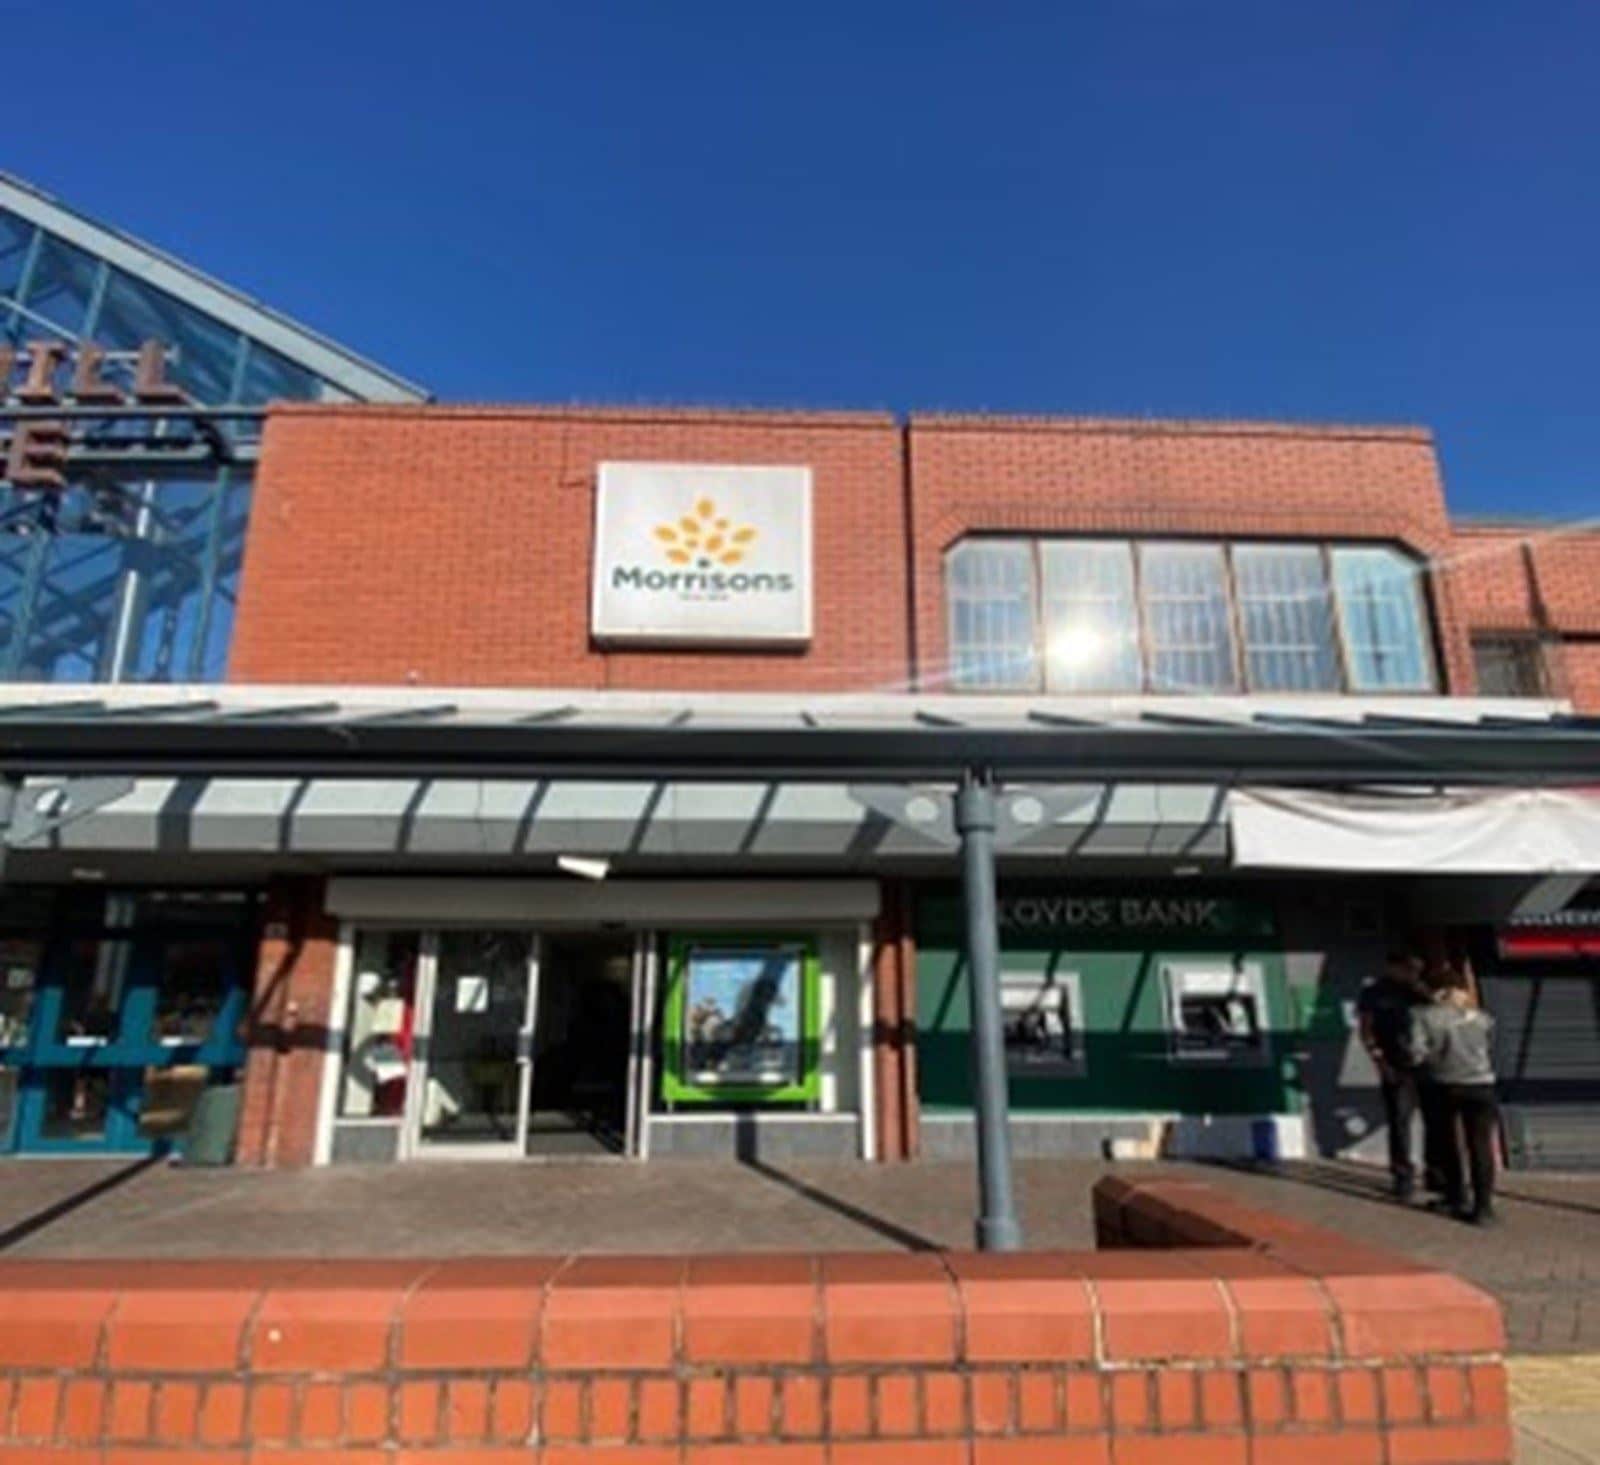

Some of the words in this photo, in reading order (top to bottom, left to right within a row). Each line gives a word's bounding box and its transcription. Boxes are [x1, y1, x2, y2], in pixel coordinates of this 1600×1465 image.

[611, 559, 794, 592] Morrisons
[998, 899, 1111, 926] LOYDS
[1120, 899, 1218, 926] BANK
